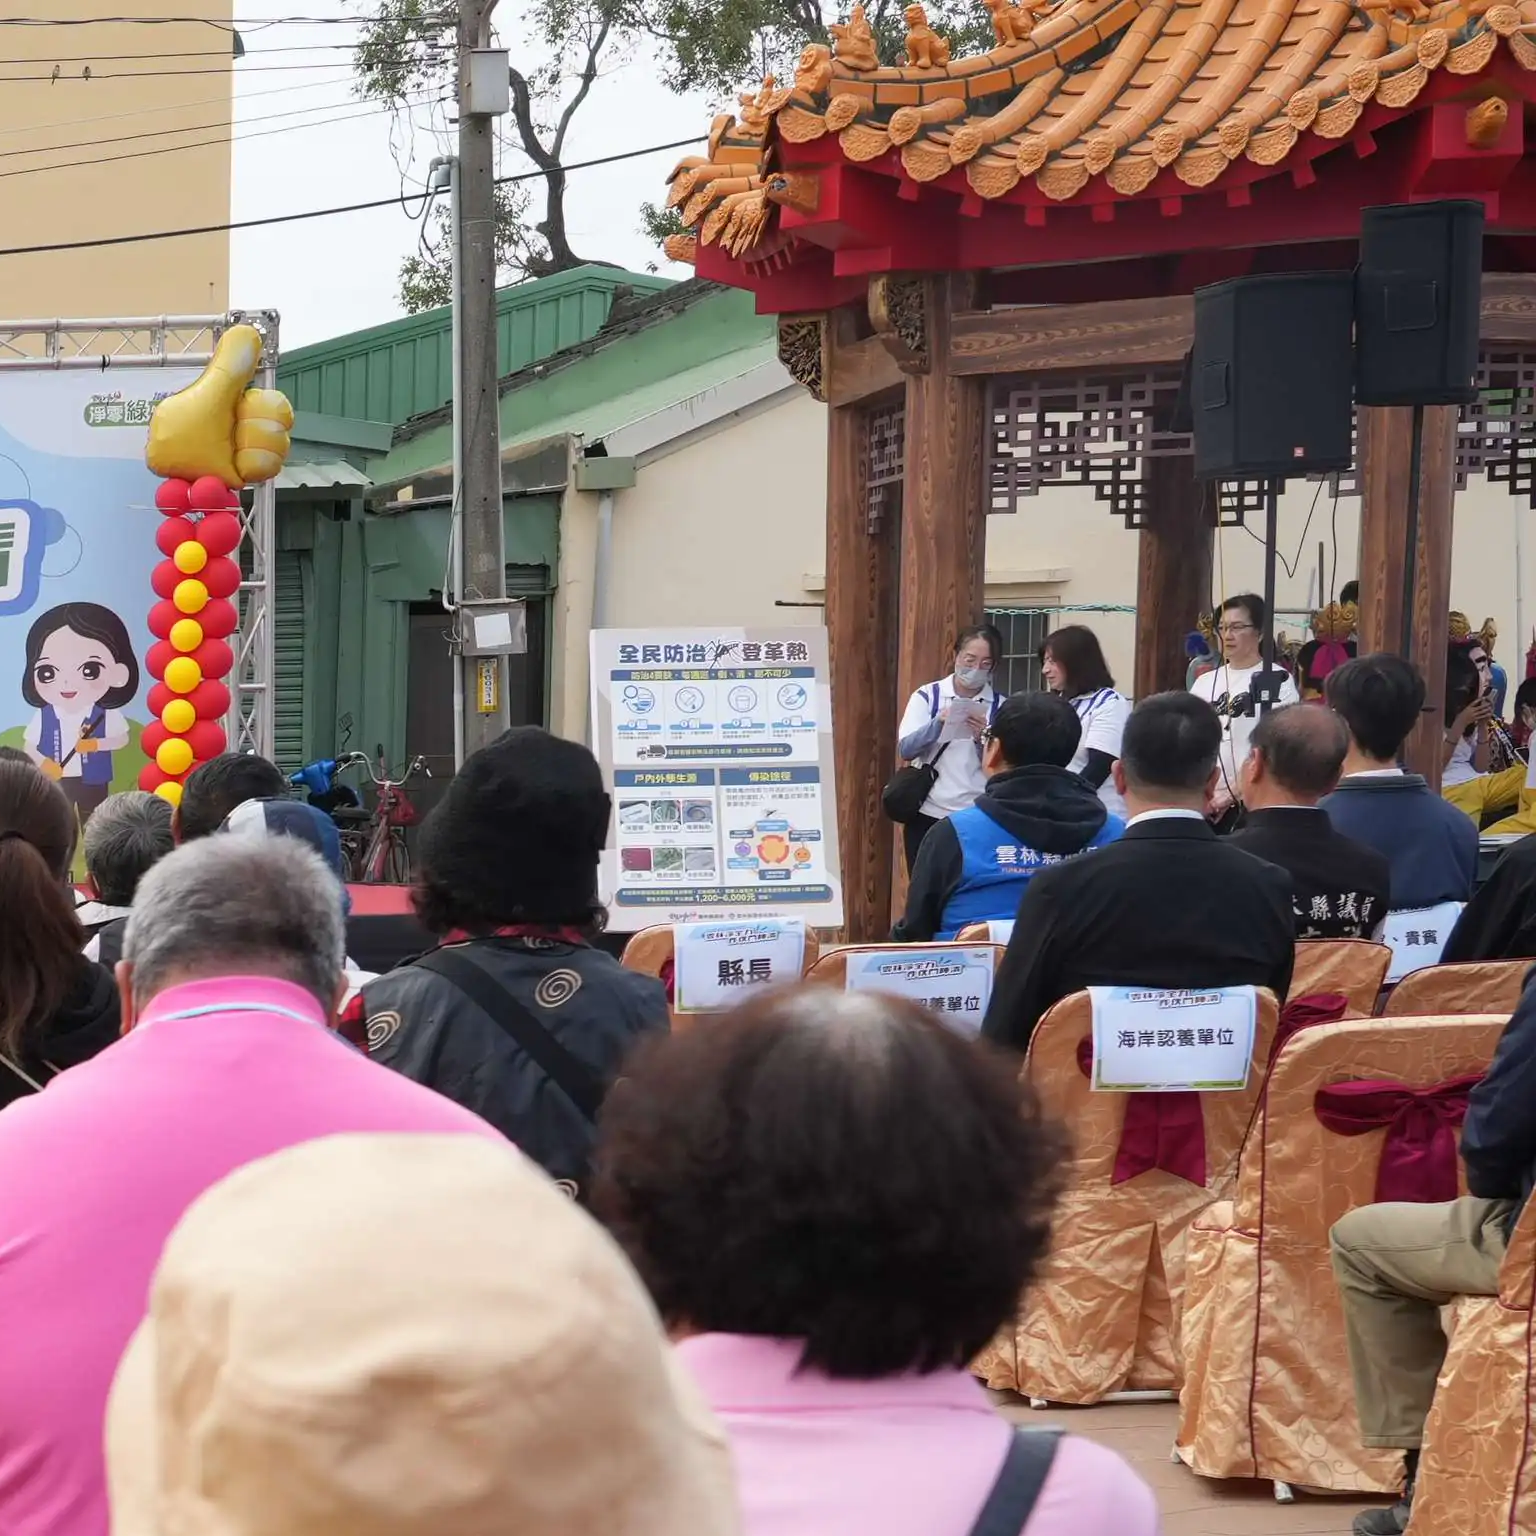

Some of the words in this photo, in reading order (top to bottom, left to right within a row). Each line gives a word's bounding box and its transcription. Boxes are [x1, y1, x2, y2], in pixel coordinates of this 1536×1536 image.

[89, 400, 156, 424] 淨零綠
[619, 643, 706, 663] 全民防治
[742, 641, 809, 662] 登革熱
[717, 958, 773, 986] 縣長
[1117, 1028, 1234, 1049] 海岸認養單位
